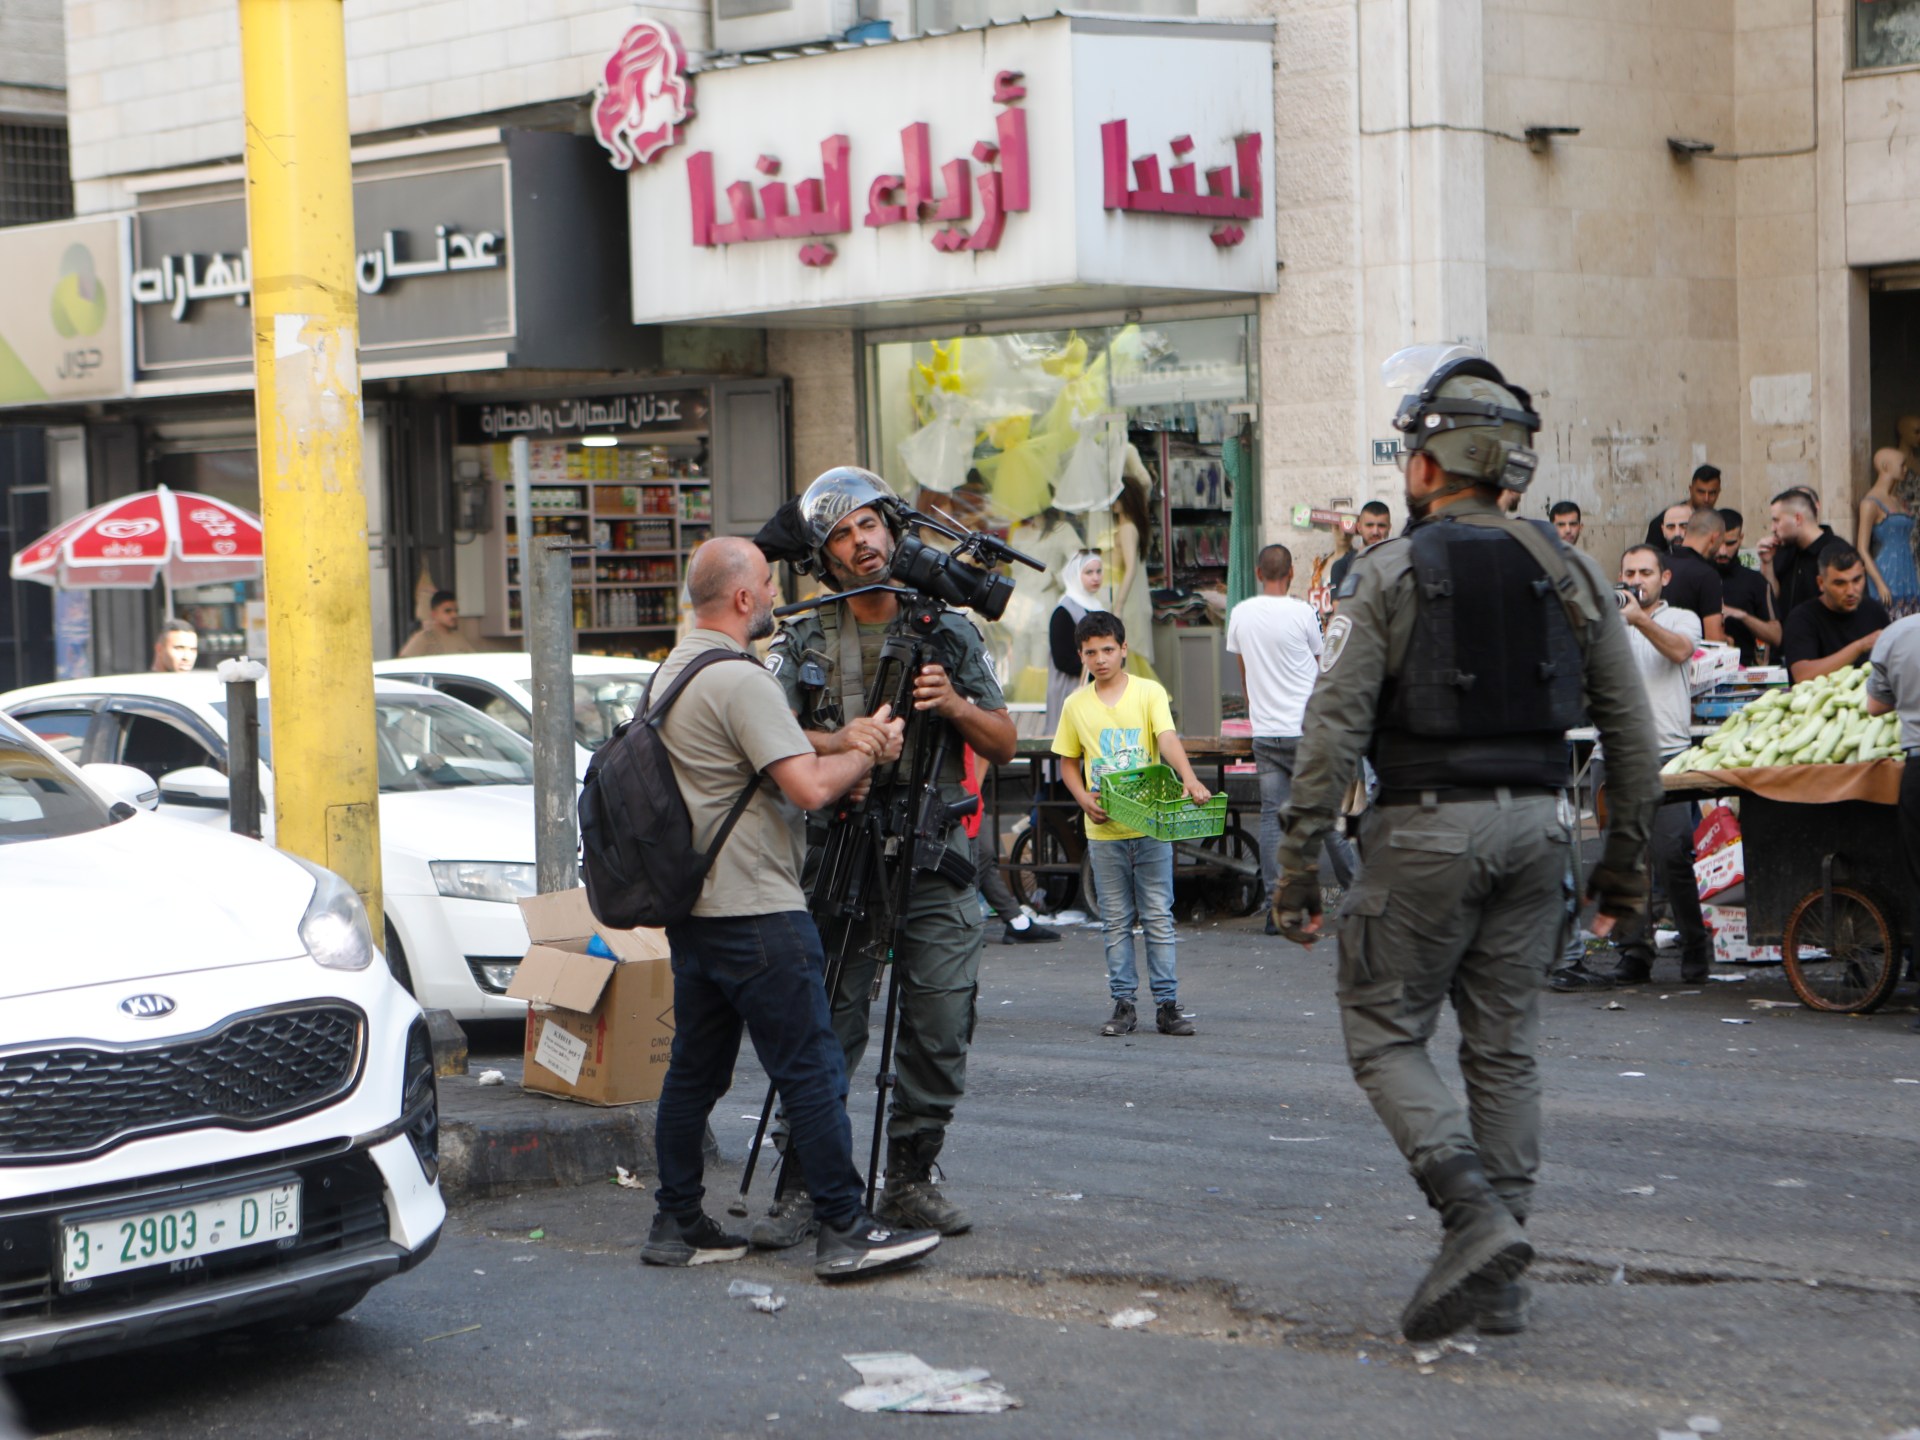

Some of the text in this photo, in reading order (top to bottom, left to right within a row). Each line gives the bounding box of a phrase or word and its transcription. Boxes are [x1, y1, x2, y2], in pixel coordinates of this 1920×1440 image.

[864, 71, 1030, 251] أزياء
[356, 225, 500, 295] عدنان
[481, 394, 682, 438] عدنان للبهارات والعطارة
[126, 996, 172, 1015] KIA
[170, 1257, 204, 1273] KIA
